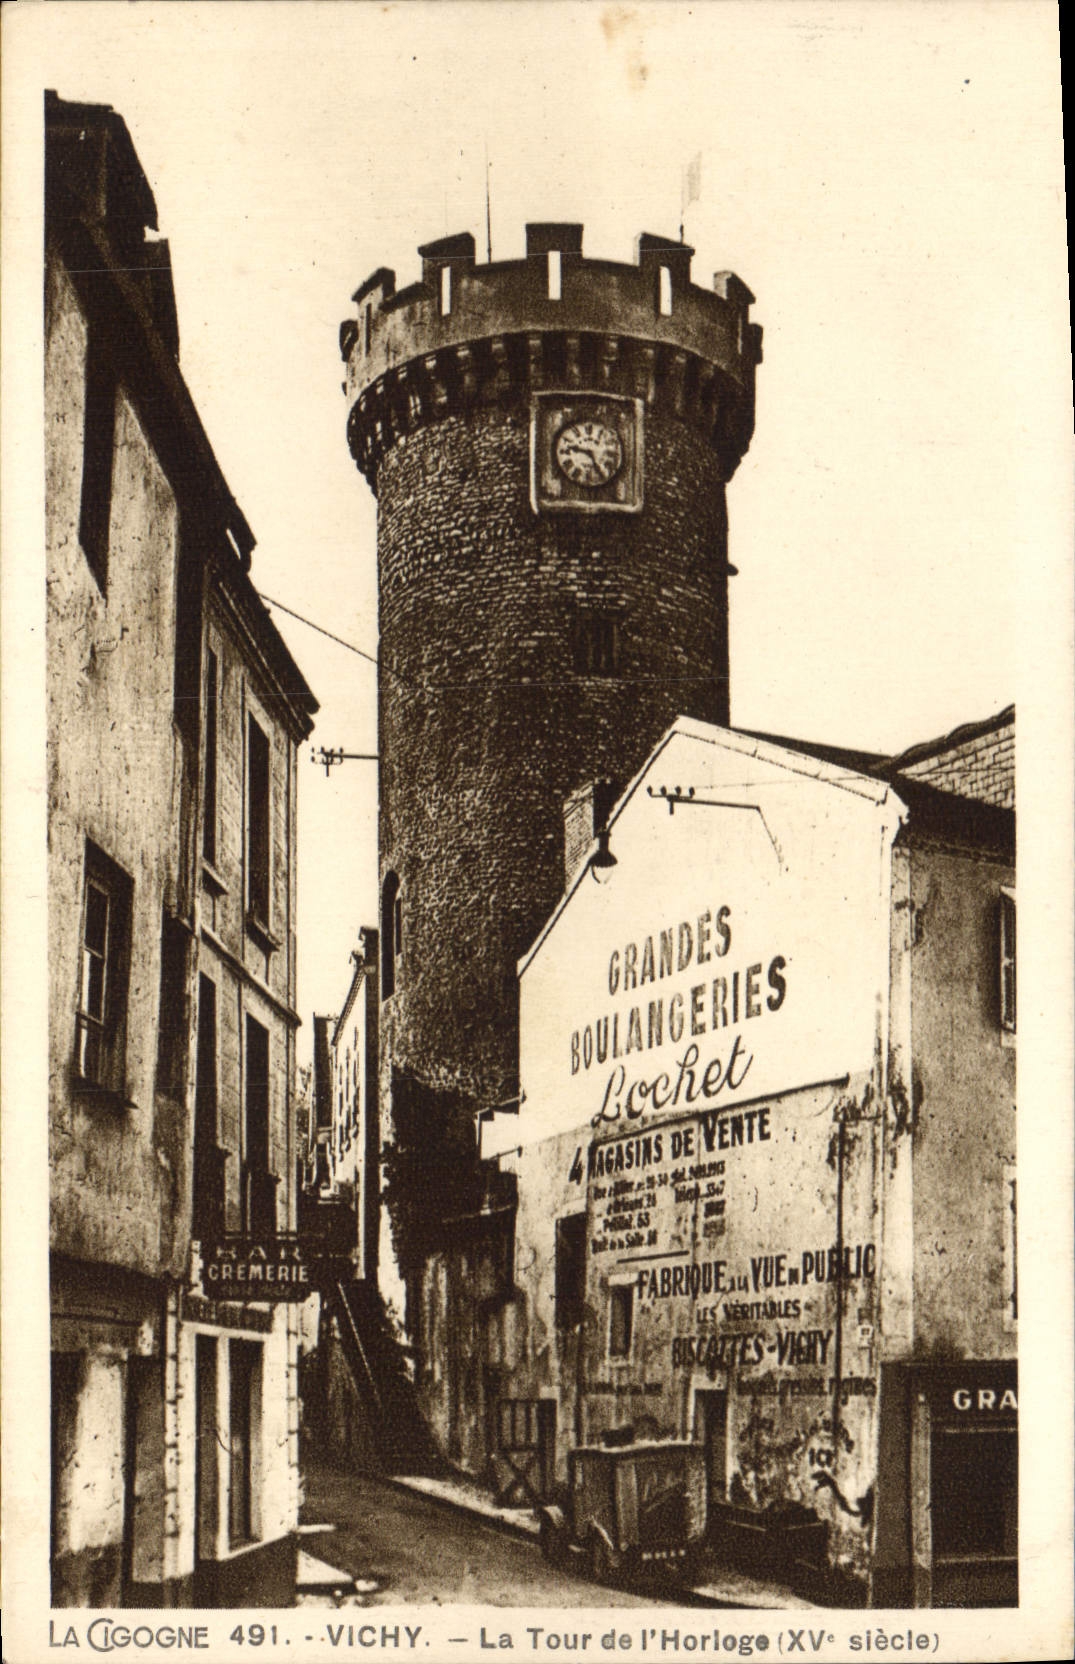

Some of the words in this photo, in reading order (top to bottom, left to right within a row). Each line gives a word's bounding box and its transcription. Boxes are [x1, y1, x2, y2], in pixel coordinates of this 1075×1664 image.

[608, 904, 732, 997] GRANDES
[570, 954, 787, 1076] BOULANGERIES
[590, 1034, 754, 1129] Lochet
[568, 1146, 583, 1186] 4
[587, 1134, 663, 1180] MAGASINS
[671, 1127, 695, 1160] DE
[701, 1107, 771, 1152] VENTE
[637, 1260, 727, 1299] FABRIQUE
[751, 1254, 787, 1293] VUE
[801, 1243, 876, 1285] PUBLIC
[953, 1389, 1018, 1411] GRA
